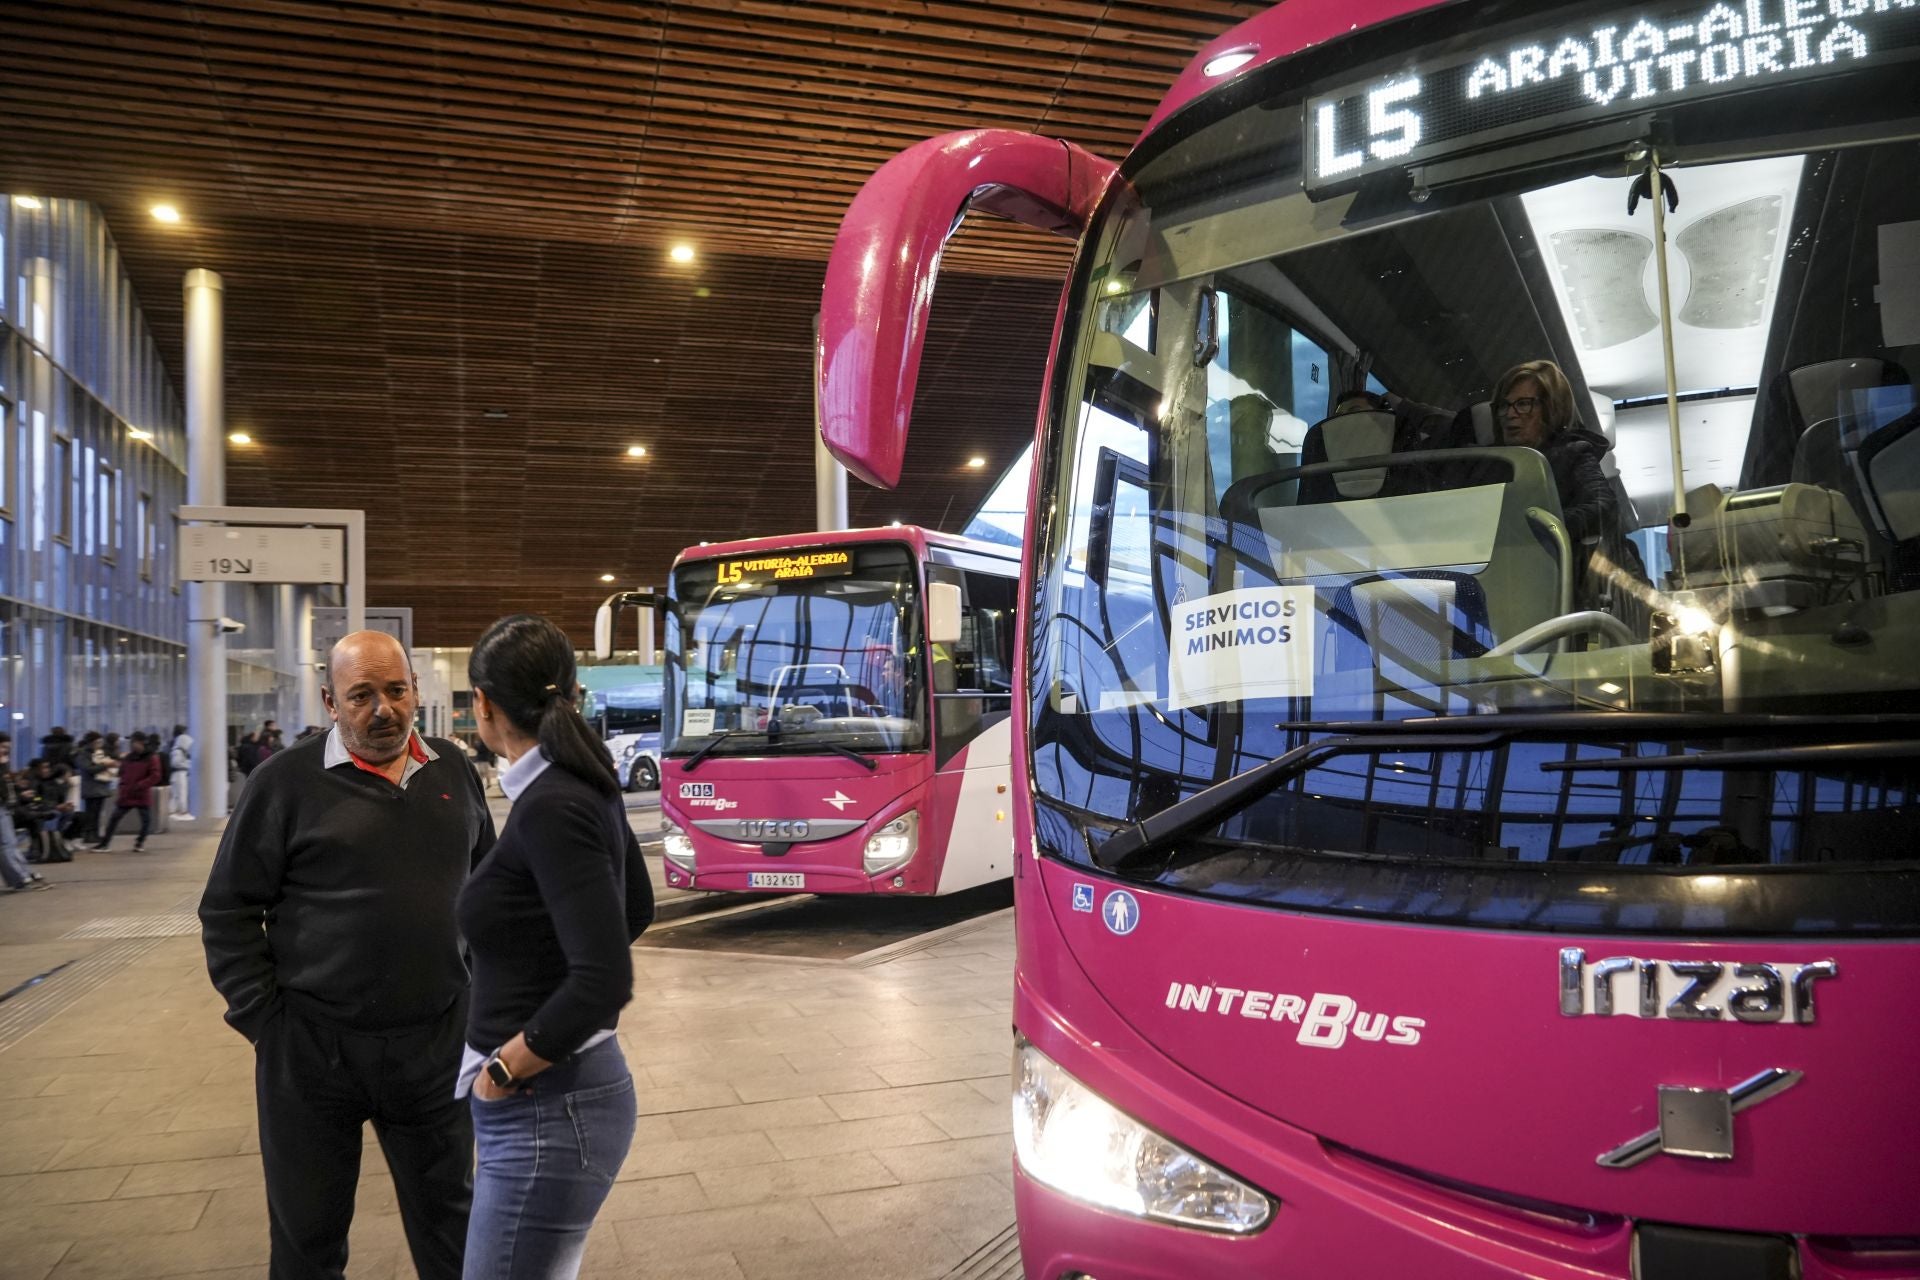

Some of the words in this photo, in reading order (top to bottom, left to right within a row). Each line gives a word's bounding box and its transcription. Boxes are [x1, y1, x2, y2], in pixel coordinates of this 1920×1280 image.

[1583, 20, 1868, 106] VITORIA
[1315, 77, 1421, 178] L5
[208, 558, 232, 574] 19
[717, 561, 743, 584] L5
[743, 552, 848, 571] VITORIA-ALEGRIA
[774, 565, 814, 579] ARAIA
[1185, 599, 1297, 632] SERVICIOS
[1187, 625, 1292, 656] MINIMOS
[740, 820, 809, 839] IVECO
[754, 876, 779, 887] 4132
[782, 875, 801, 887] KST
[1559, 947, 1838, 1024] Irizar
